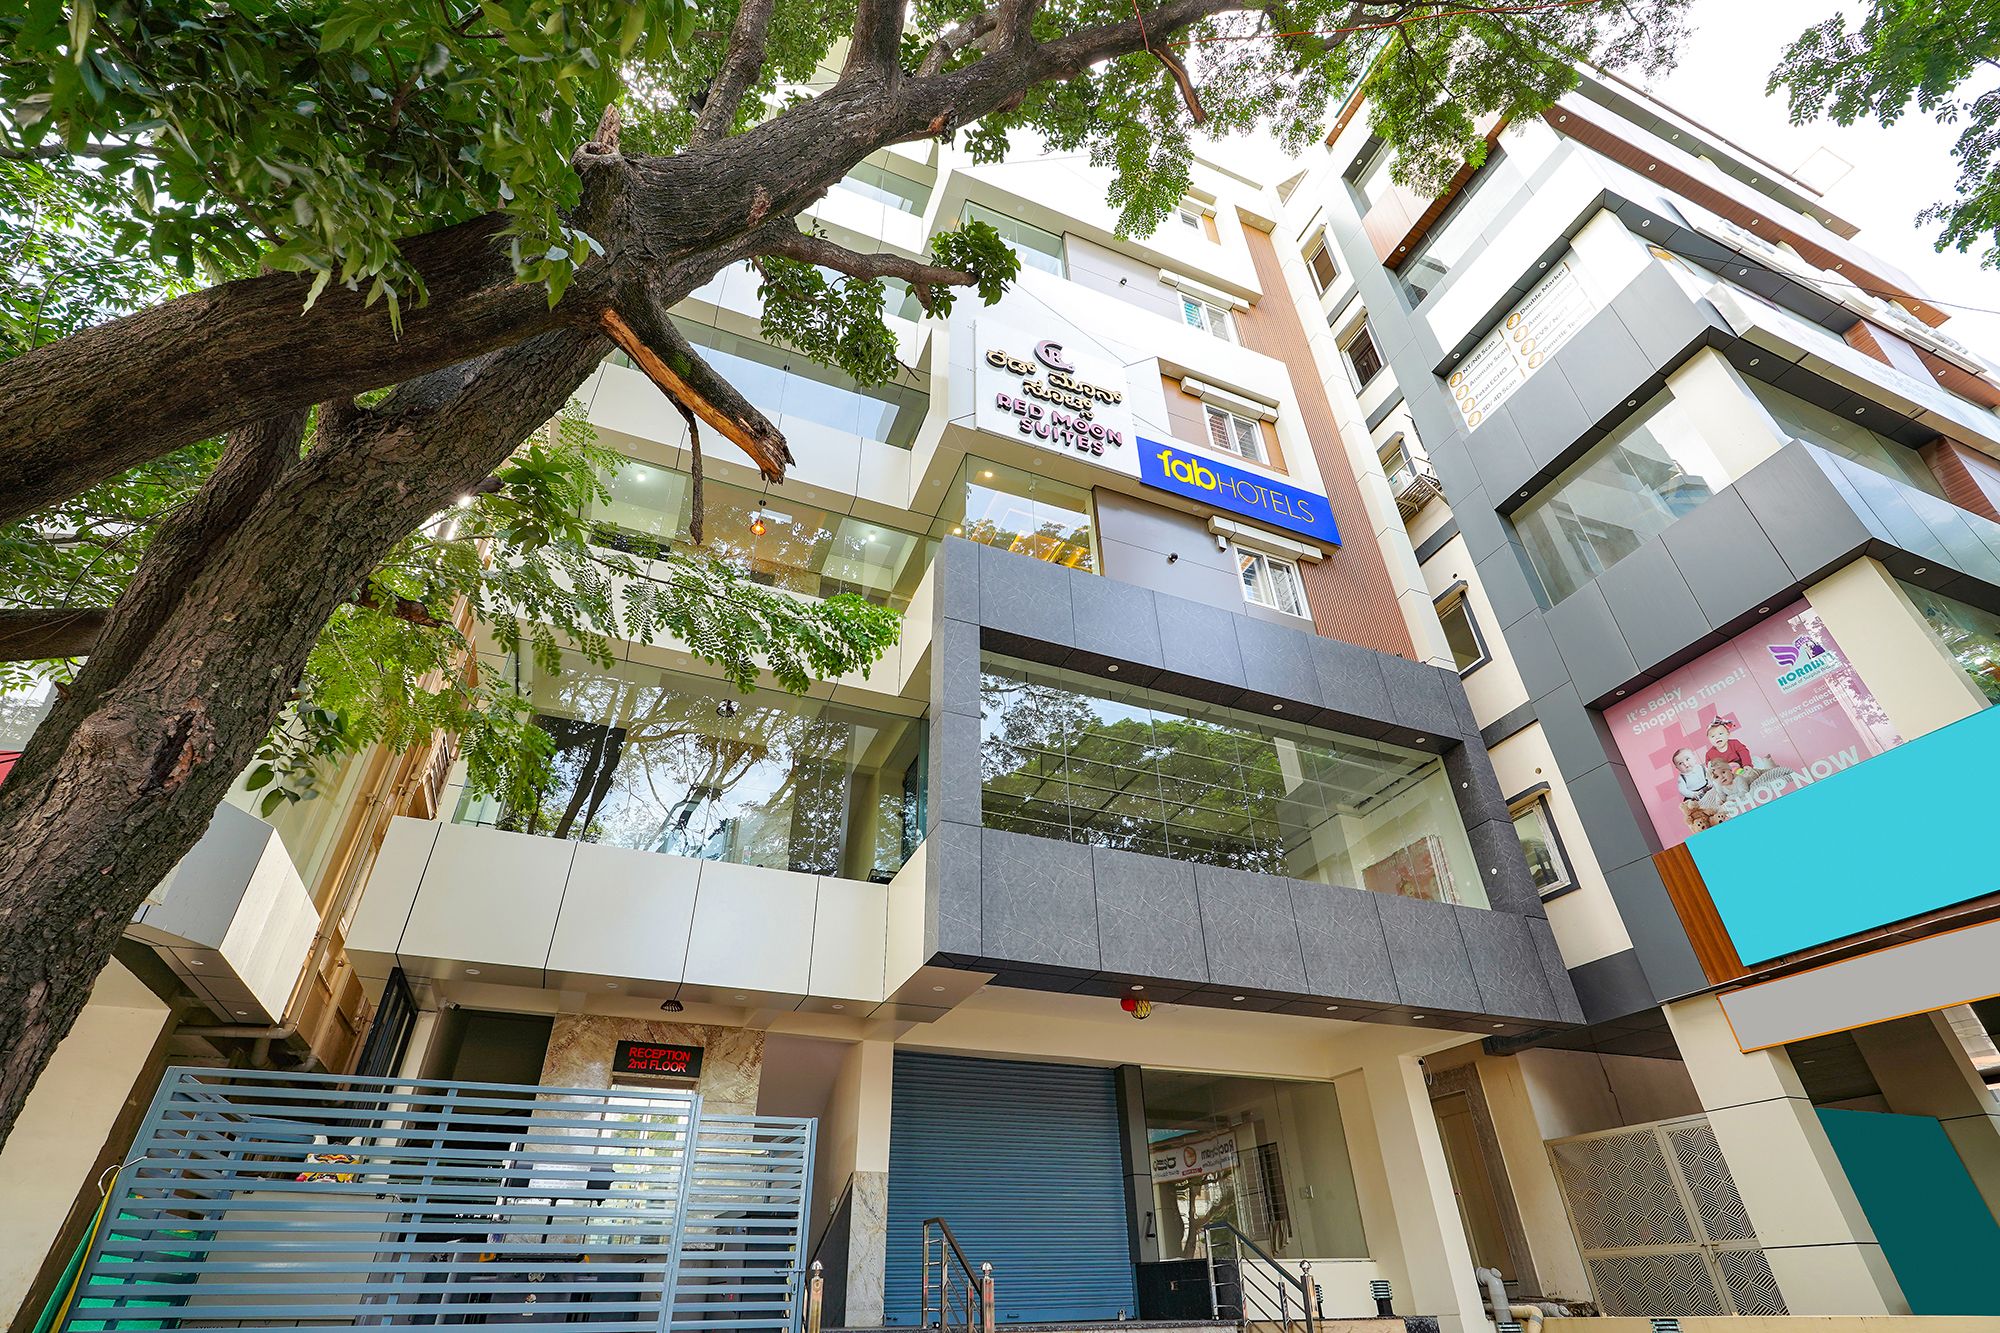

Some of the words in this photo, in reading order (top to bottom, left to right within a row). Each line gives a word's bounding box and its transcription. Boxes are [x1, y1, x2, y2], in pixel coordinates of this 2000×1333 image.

[1542, 268, 1566, 293] Marker
[1535, 325, 1549, 341] CVS
[1481, 340, 1496, 355] Scan
[1494, 347, 1508, 361] Scan
[1502, 379, 1517, 394] Scan
[996, 392, 1045, 420] RED
[1052, 410, 1123, 447] MOON
[1019, 416, 1104, 456] SUITES
[1778, 652, 1837, 687] HORNBI
[1632, 696, 1698, 736] Shopping
[1696, 667, 1746, 700] Time!!
[1648, 687, 1682, 712] Baby
[1784, 704, 1824, 726] Premium
[1723, 778, 1788, 818] SHOP
[1789, 745, 1861, 789] NOW
[628, 1058, 647, 1070] 2nd
[649, 1060, 686, 1072] FLOOR
[629, 1047, 691, 1062] RECEPTION
